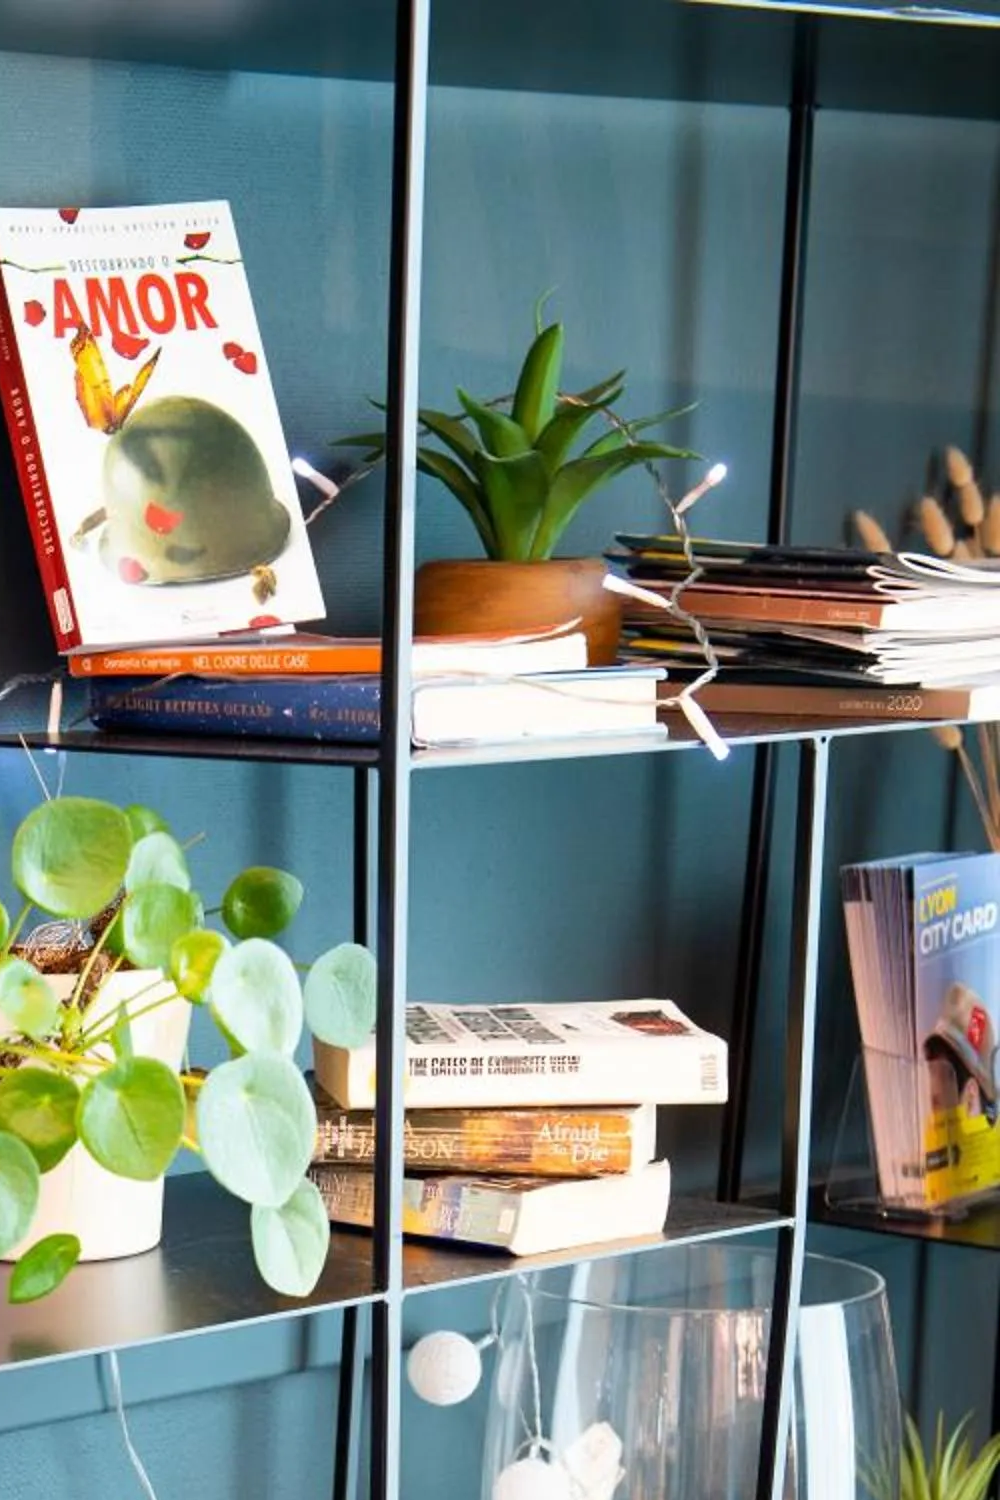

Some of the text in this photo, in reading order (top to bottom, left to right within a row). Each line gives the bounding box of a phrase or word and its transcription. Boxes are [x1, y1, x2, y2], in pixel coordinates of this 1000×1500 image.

[68, 255, 171, 273] DESCOBRINDO O
[53, 271, 219, 339] AMOR
[214, 654, 247, 669] CUORE
[250, 654, 280, 668] DELLE
[283, 654, 310, 669] CASE
[887, 695, 922, 711] 2020
[920, 886, 956, 923] LYON
[920, 902, 998, 955] CITY CARD
[538, 1121, 600, 1141] Afraid
[571, 1143, 609, 1163] Die
